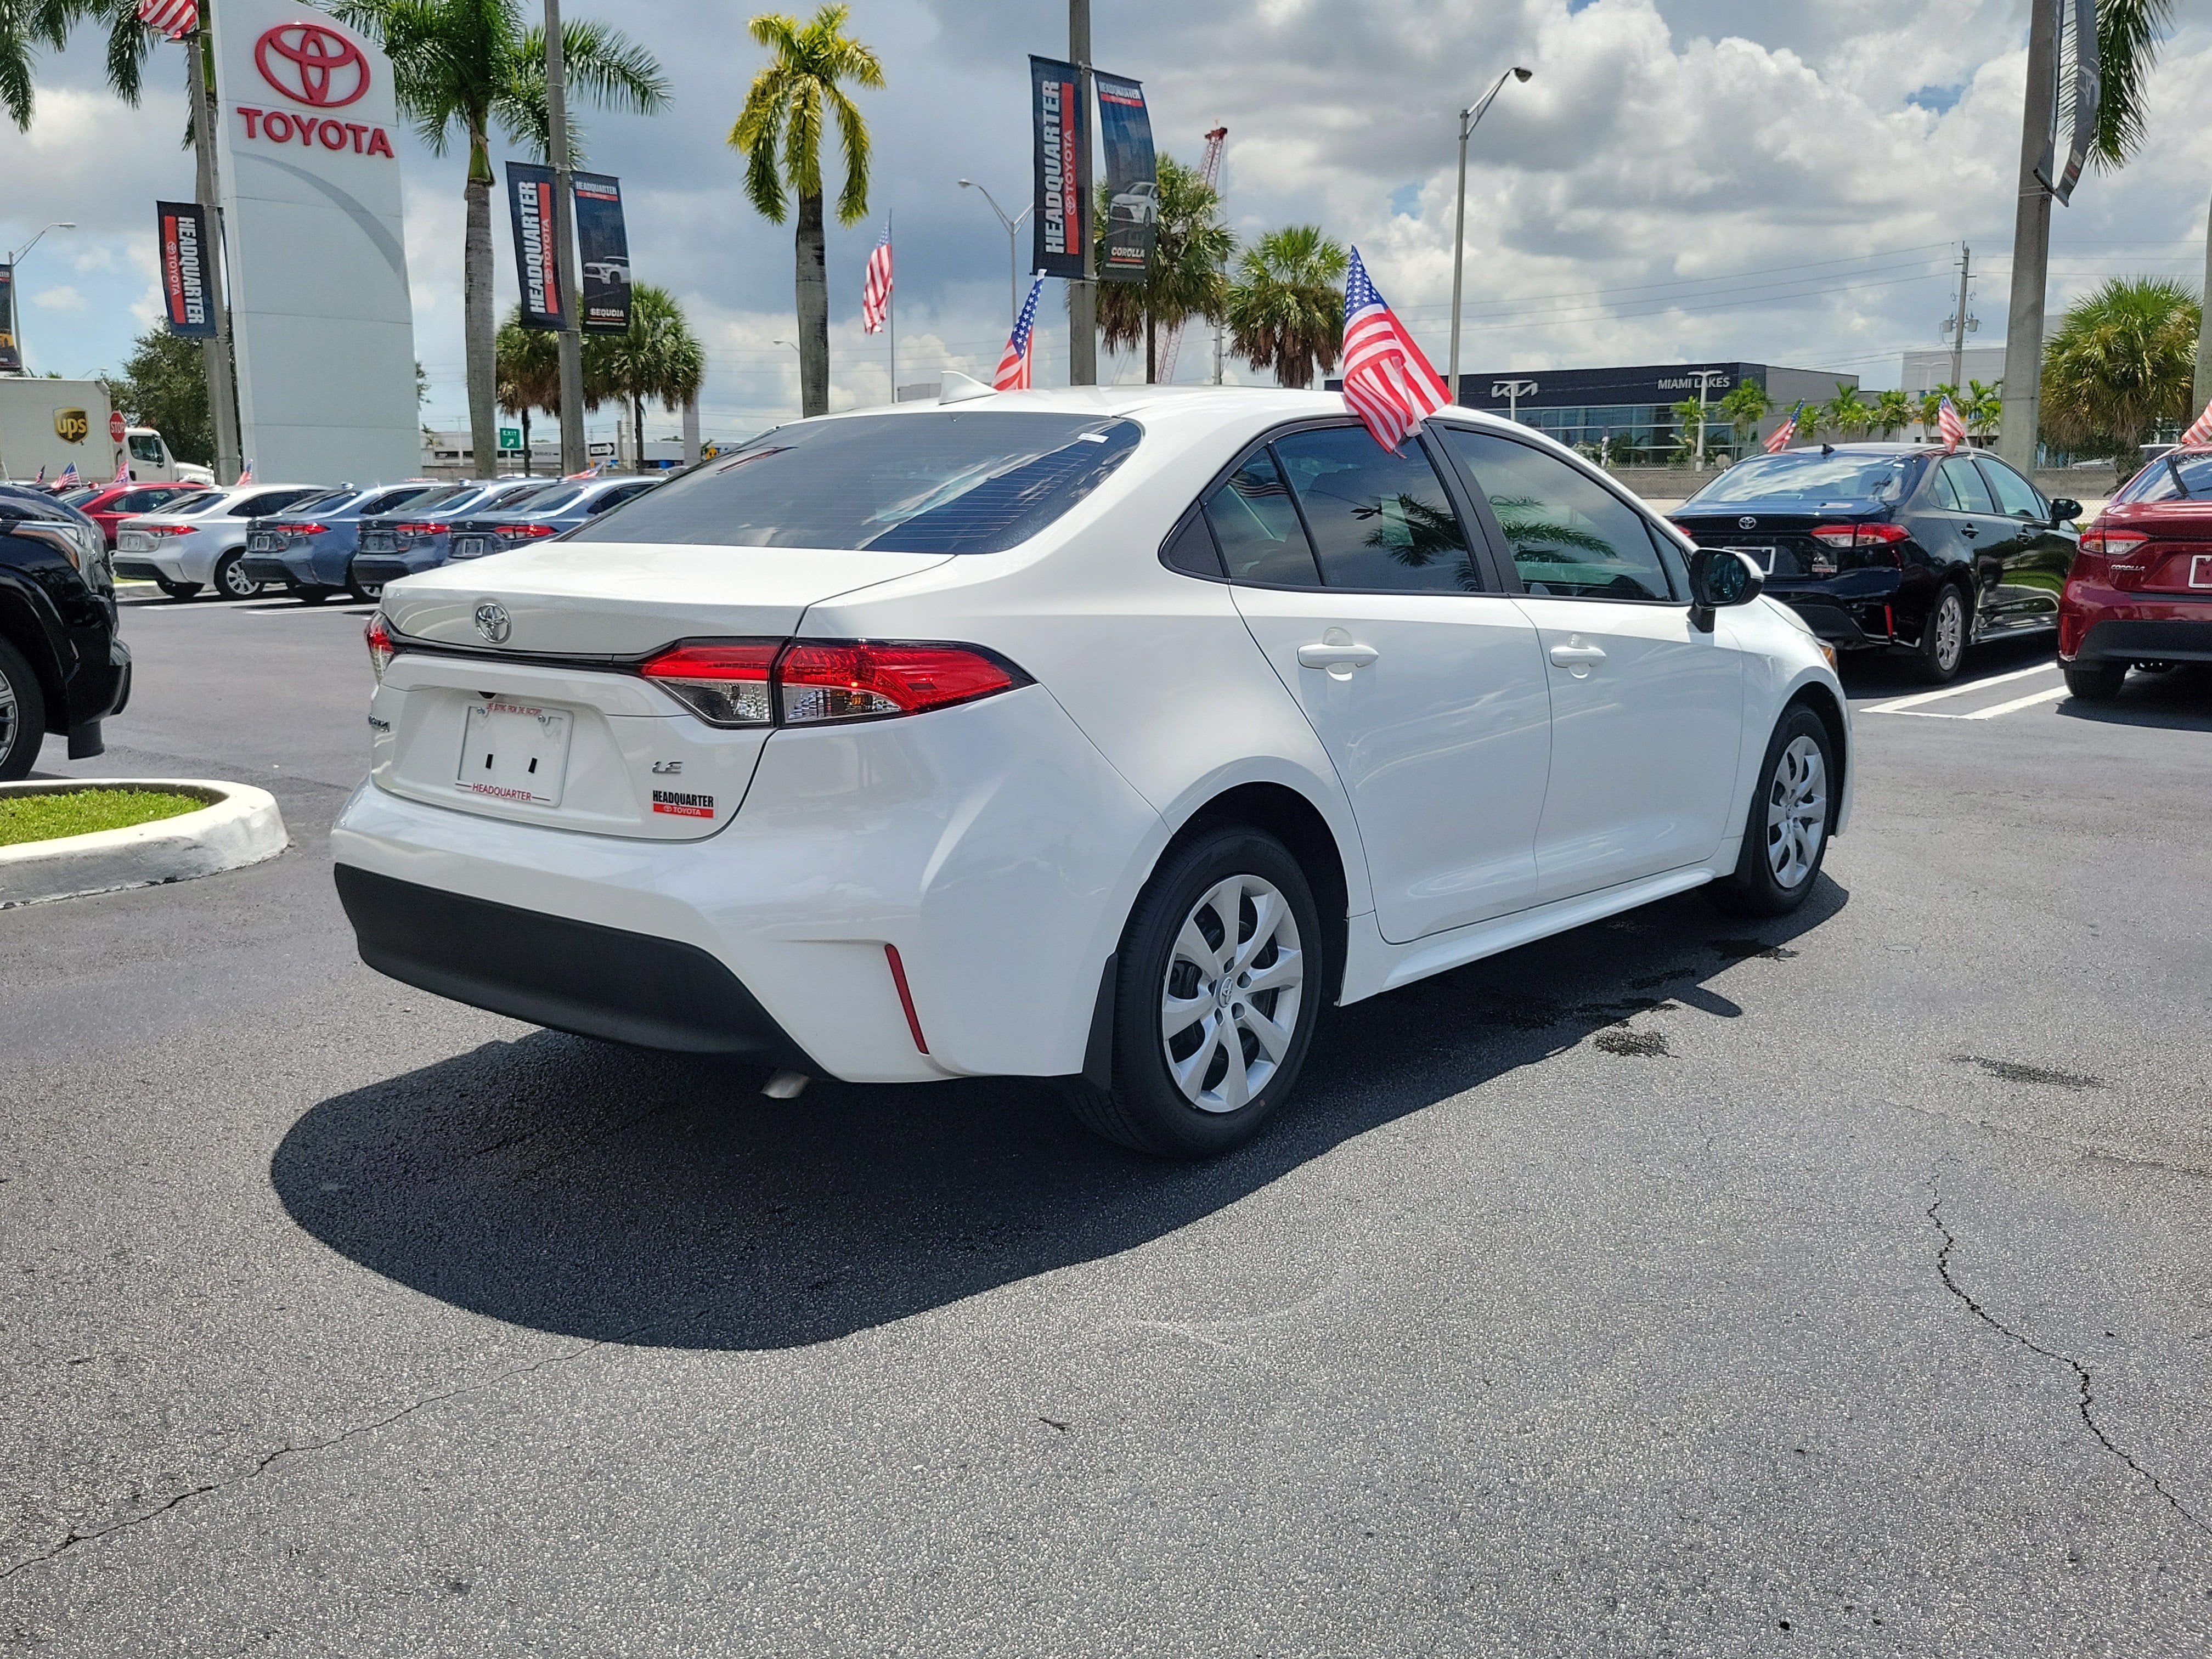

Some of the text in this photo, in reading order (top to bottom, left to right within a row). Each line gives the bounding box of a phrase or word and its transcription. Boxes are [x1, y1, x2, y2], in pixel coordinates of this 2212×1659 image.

[237, 107, 394, 158] TOYOTA
[1042, 81, 1065, 254] HEADQUARTER
[1063, 129, 1075, 190] TOYOTA
[519, 182, 546, 313] HEADQUARTER
[541, 218, 553, 266] TOYOTA
[1111, 247, 1146, 258] COROLLA
[168, 255, 181, 296] TOYOTA
[178, 217, 205, 324] HEADQUARTER
[590, 308, 624, 317] SEQUOIA
[1658, 379, 1691, 390] MIAMI
[58, 418, 87, 439] ups
[110, 421, 125, 433] STOP
[652, 761, 683, 774] LE
[472, 783, 531, 801] HEADQUARTER
[653, 790, 714, 808] HEADQUARTER
[673, 806, 702, 816] TOYOTA
